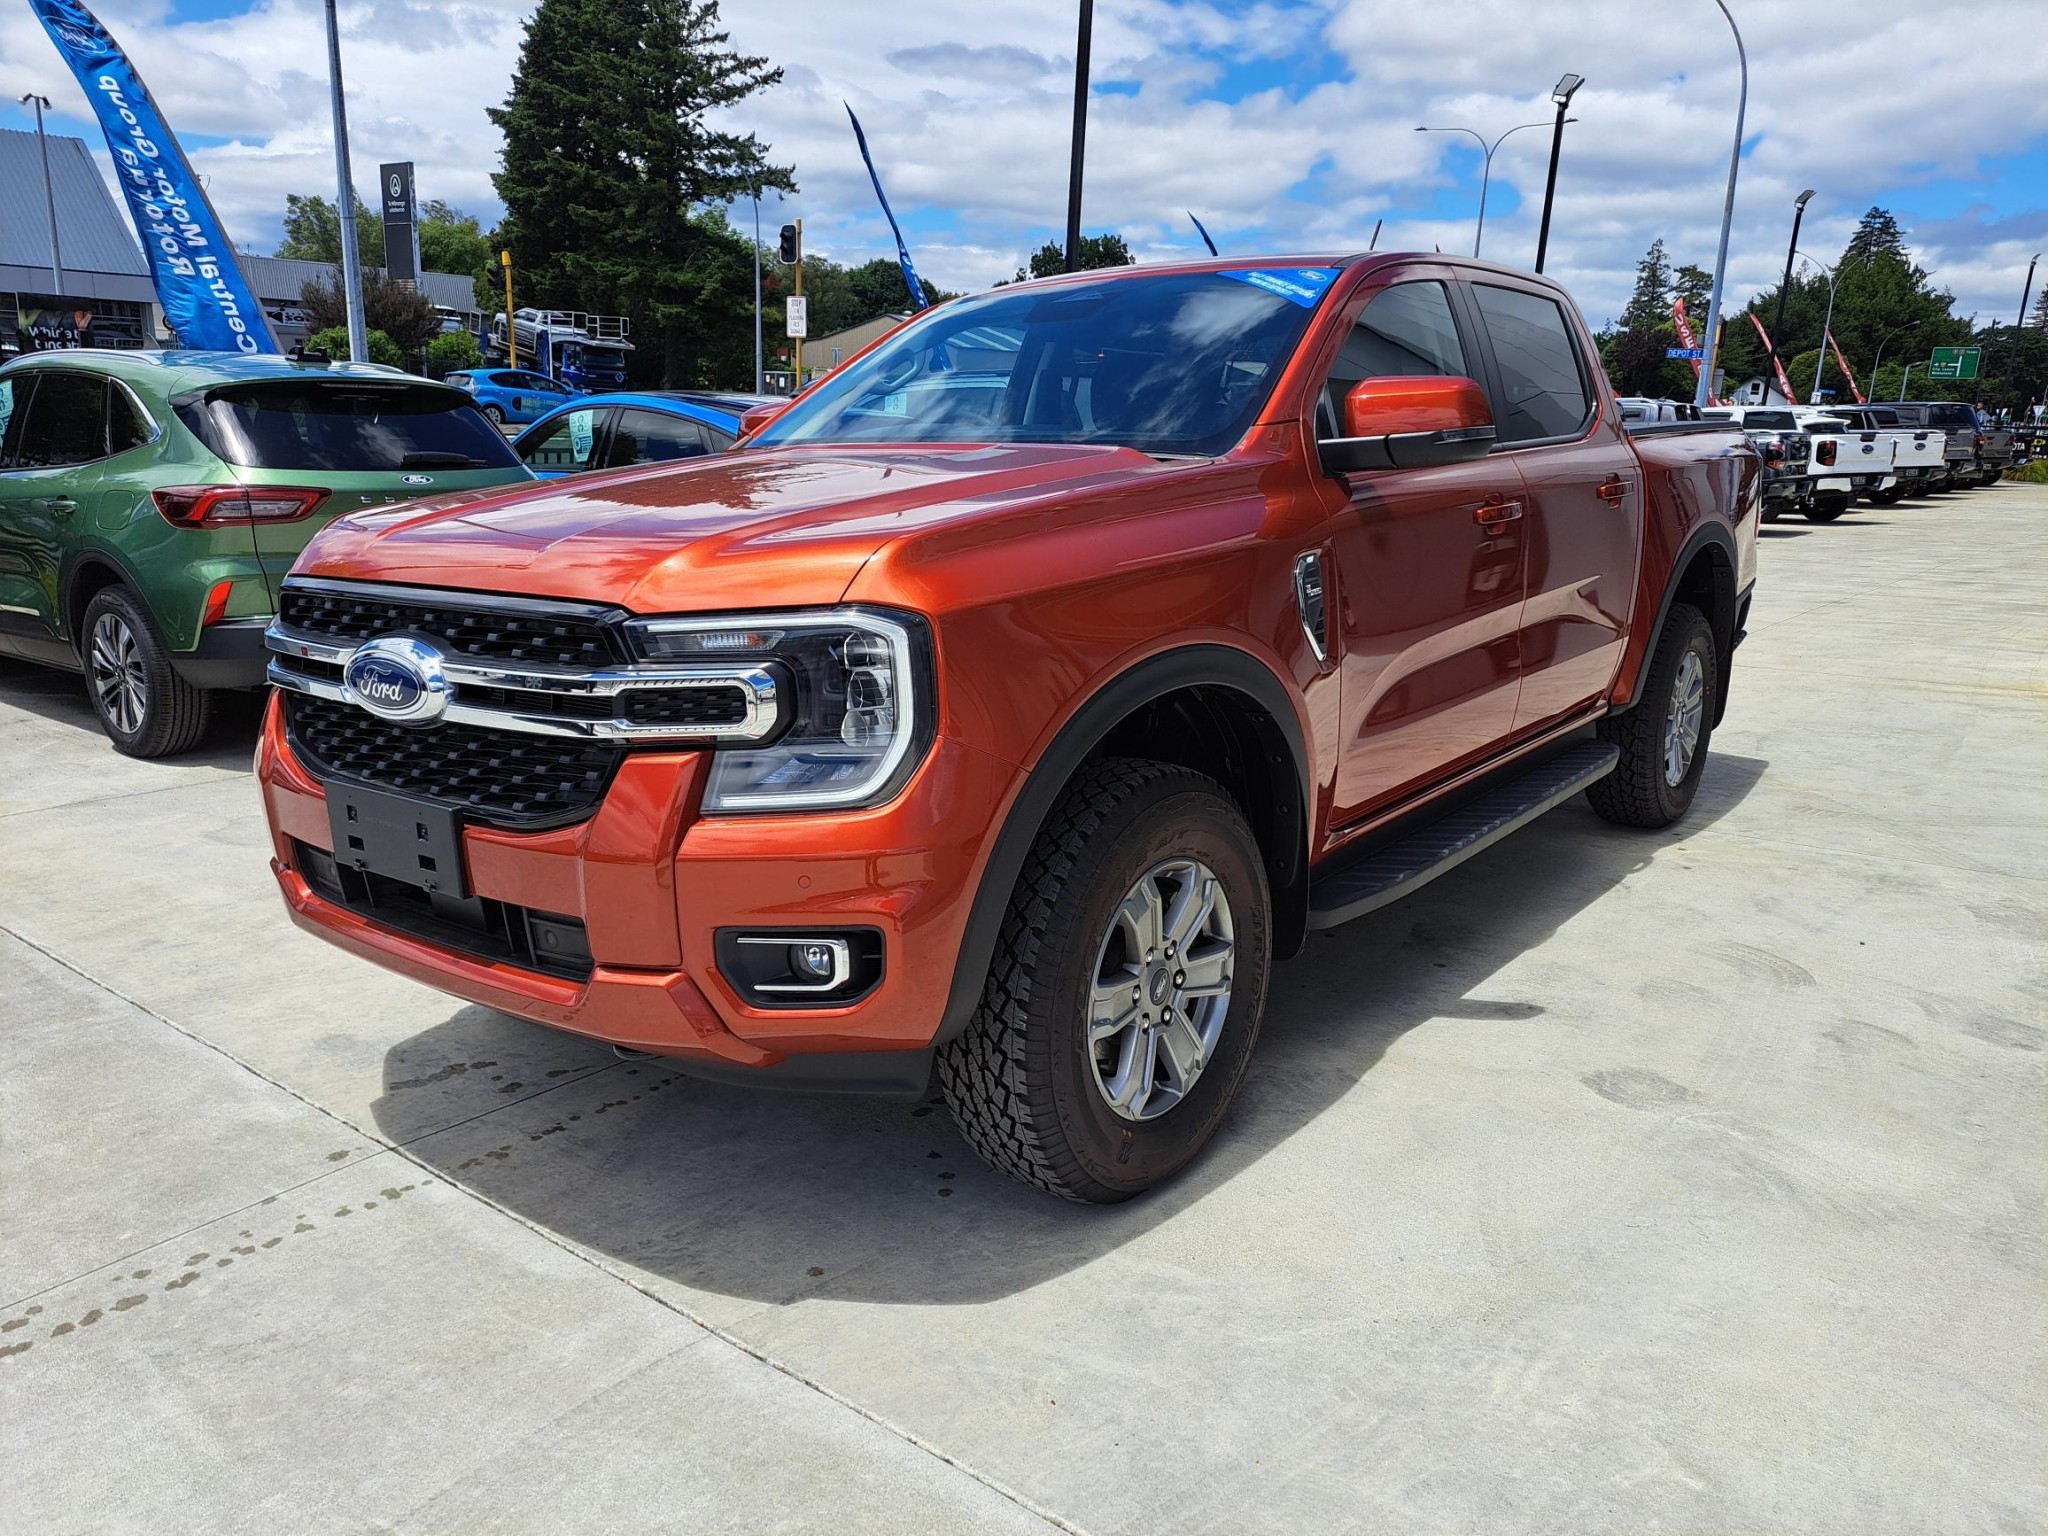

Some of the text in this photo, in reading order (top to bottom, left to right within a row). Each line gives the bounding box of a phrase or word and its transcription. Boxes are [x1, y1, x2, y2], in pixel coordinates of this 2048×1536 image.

[1667, 349, 1690, 357] DEPOT
[408, 475, 428, 484] Ford
[360, 664, 403, 702] Ford
